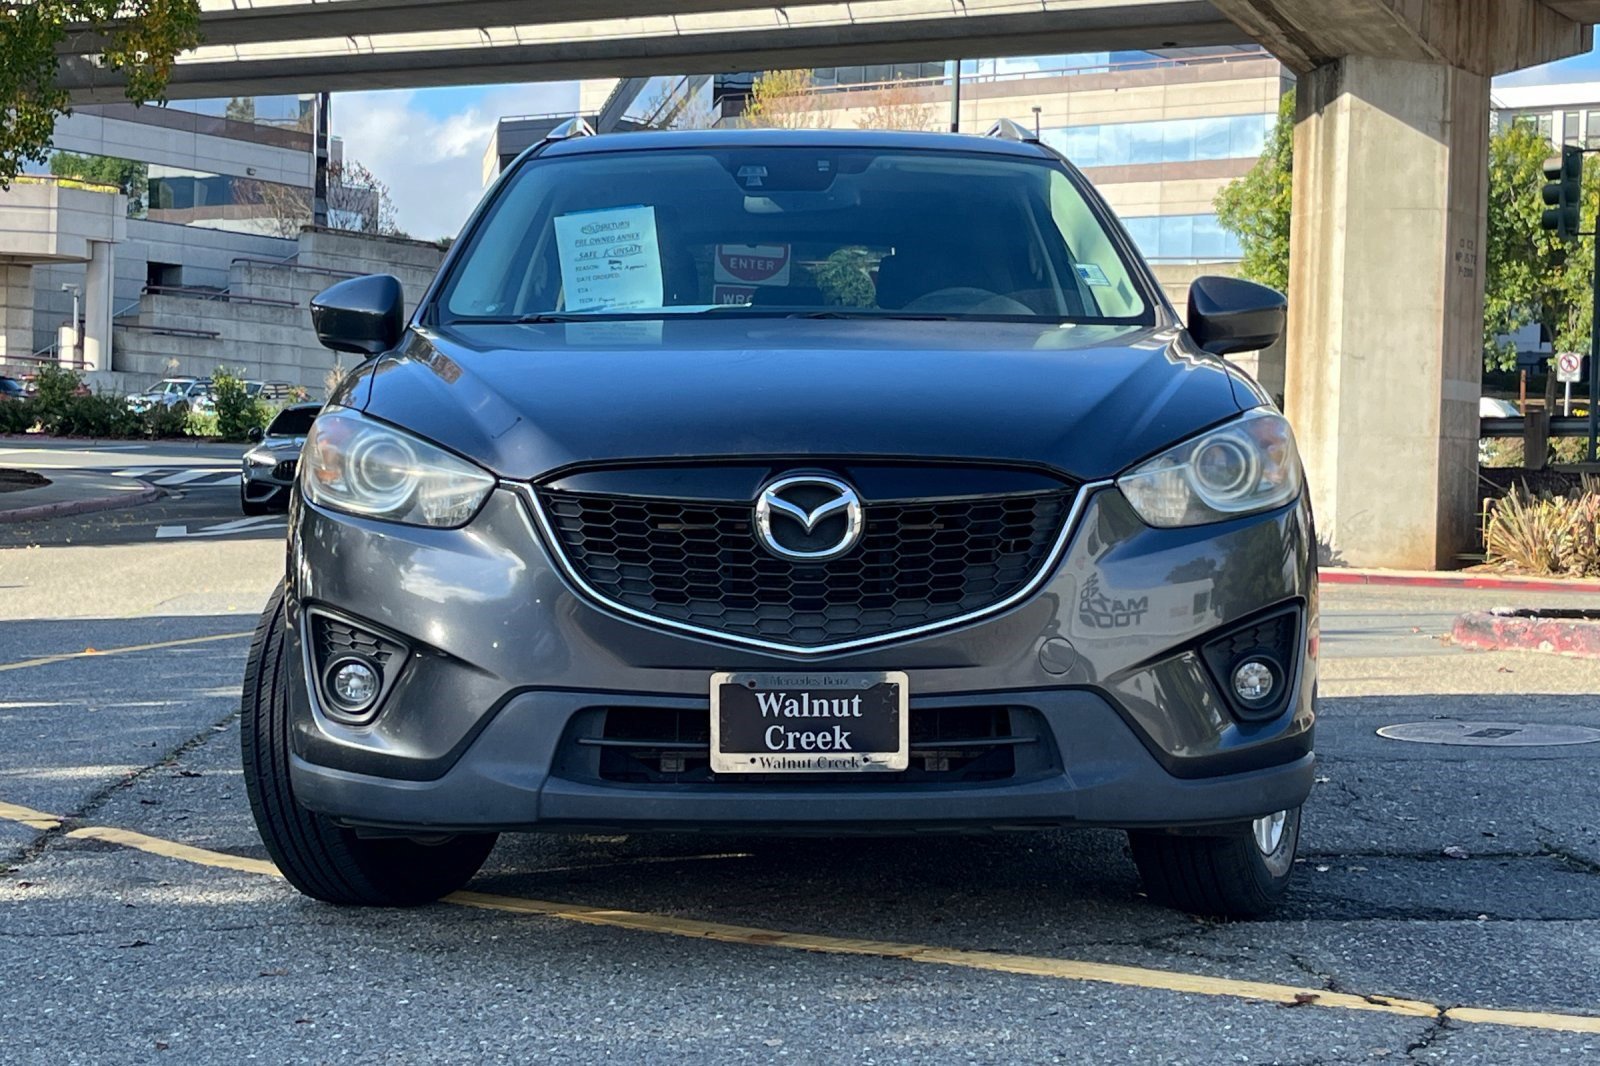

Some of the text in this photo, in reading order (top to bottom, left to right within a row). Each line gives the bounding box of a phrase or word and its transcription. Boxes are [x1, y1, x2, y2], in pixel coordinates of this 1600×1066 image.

[579, 250, 597, 258] SAFE
[730, 257, 775, 270] ENTER
[755, 692, 863, 718] Walnut
[765, 725, 852, 750] Creek
[759, 756, 861, 770] Walnut Creek
